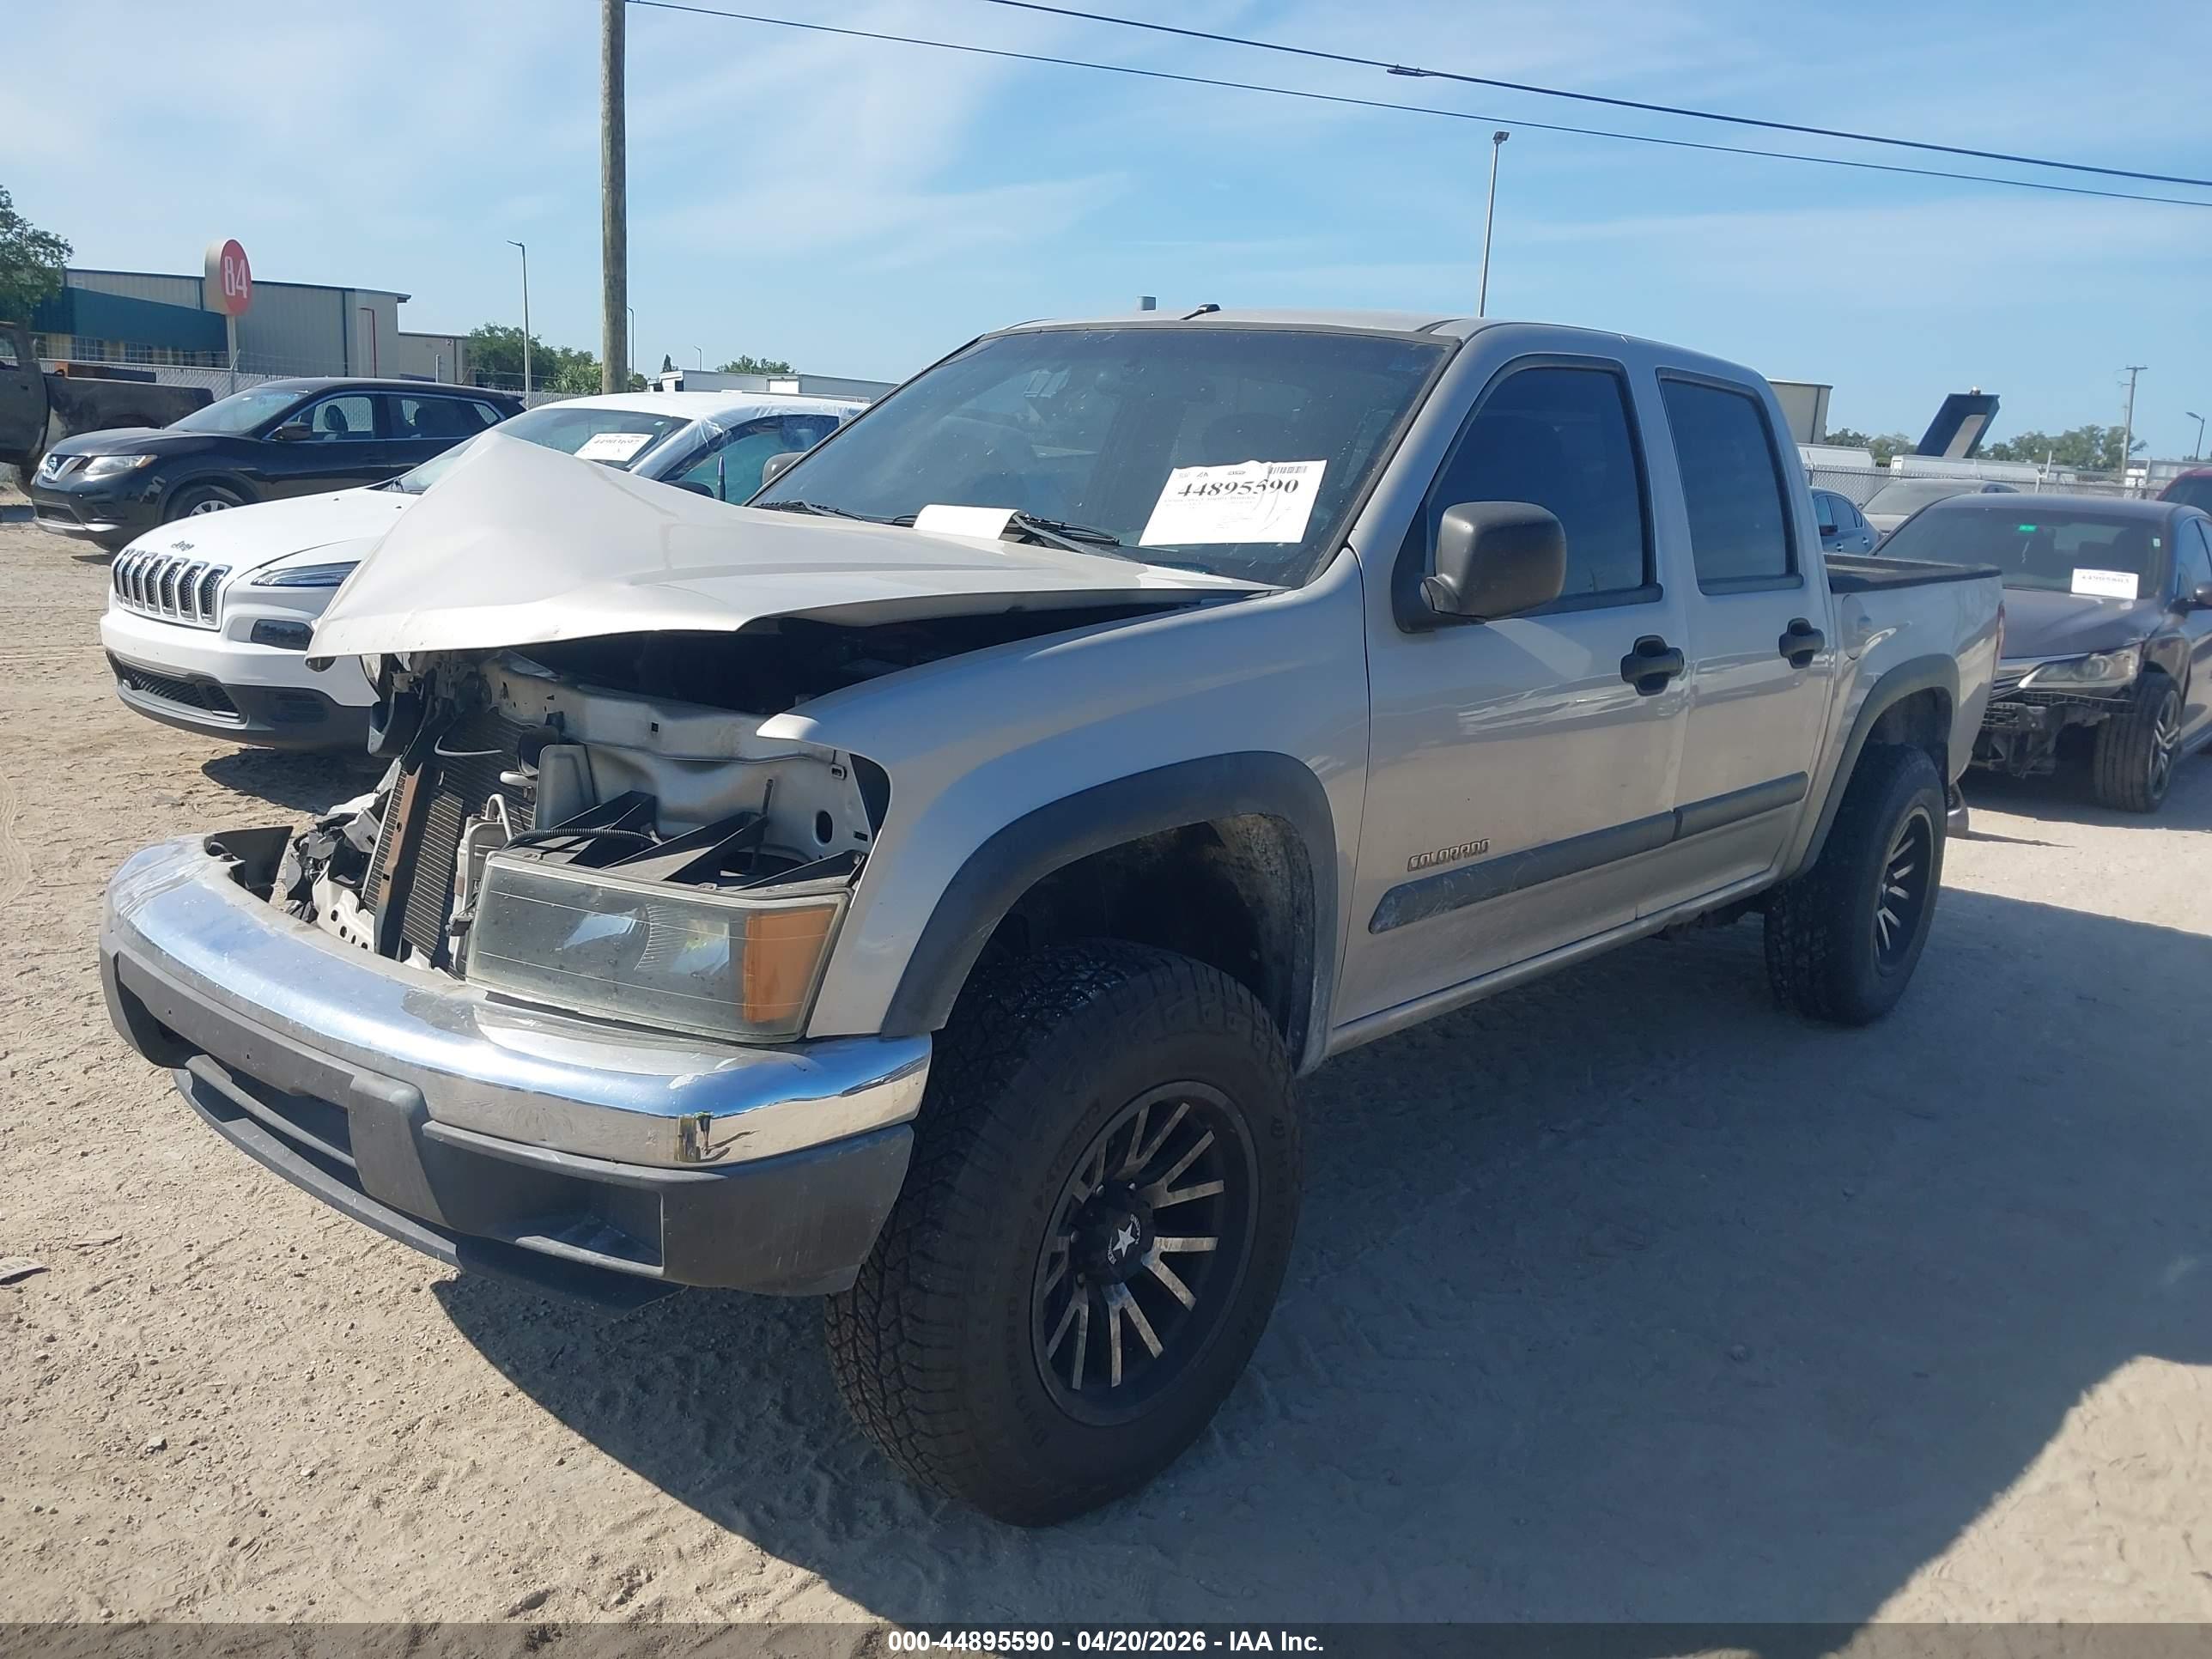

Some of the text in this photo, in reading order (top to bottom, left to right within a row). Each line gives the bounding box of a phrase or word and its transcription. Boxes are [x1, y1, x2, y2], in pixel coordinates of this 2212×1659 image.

[224, 256, 247, 299] 84
[1177, 478, 1299, 497] 44895590
[1407, 838, 1491, 872] COLORADO
